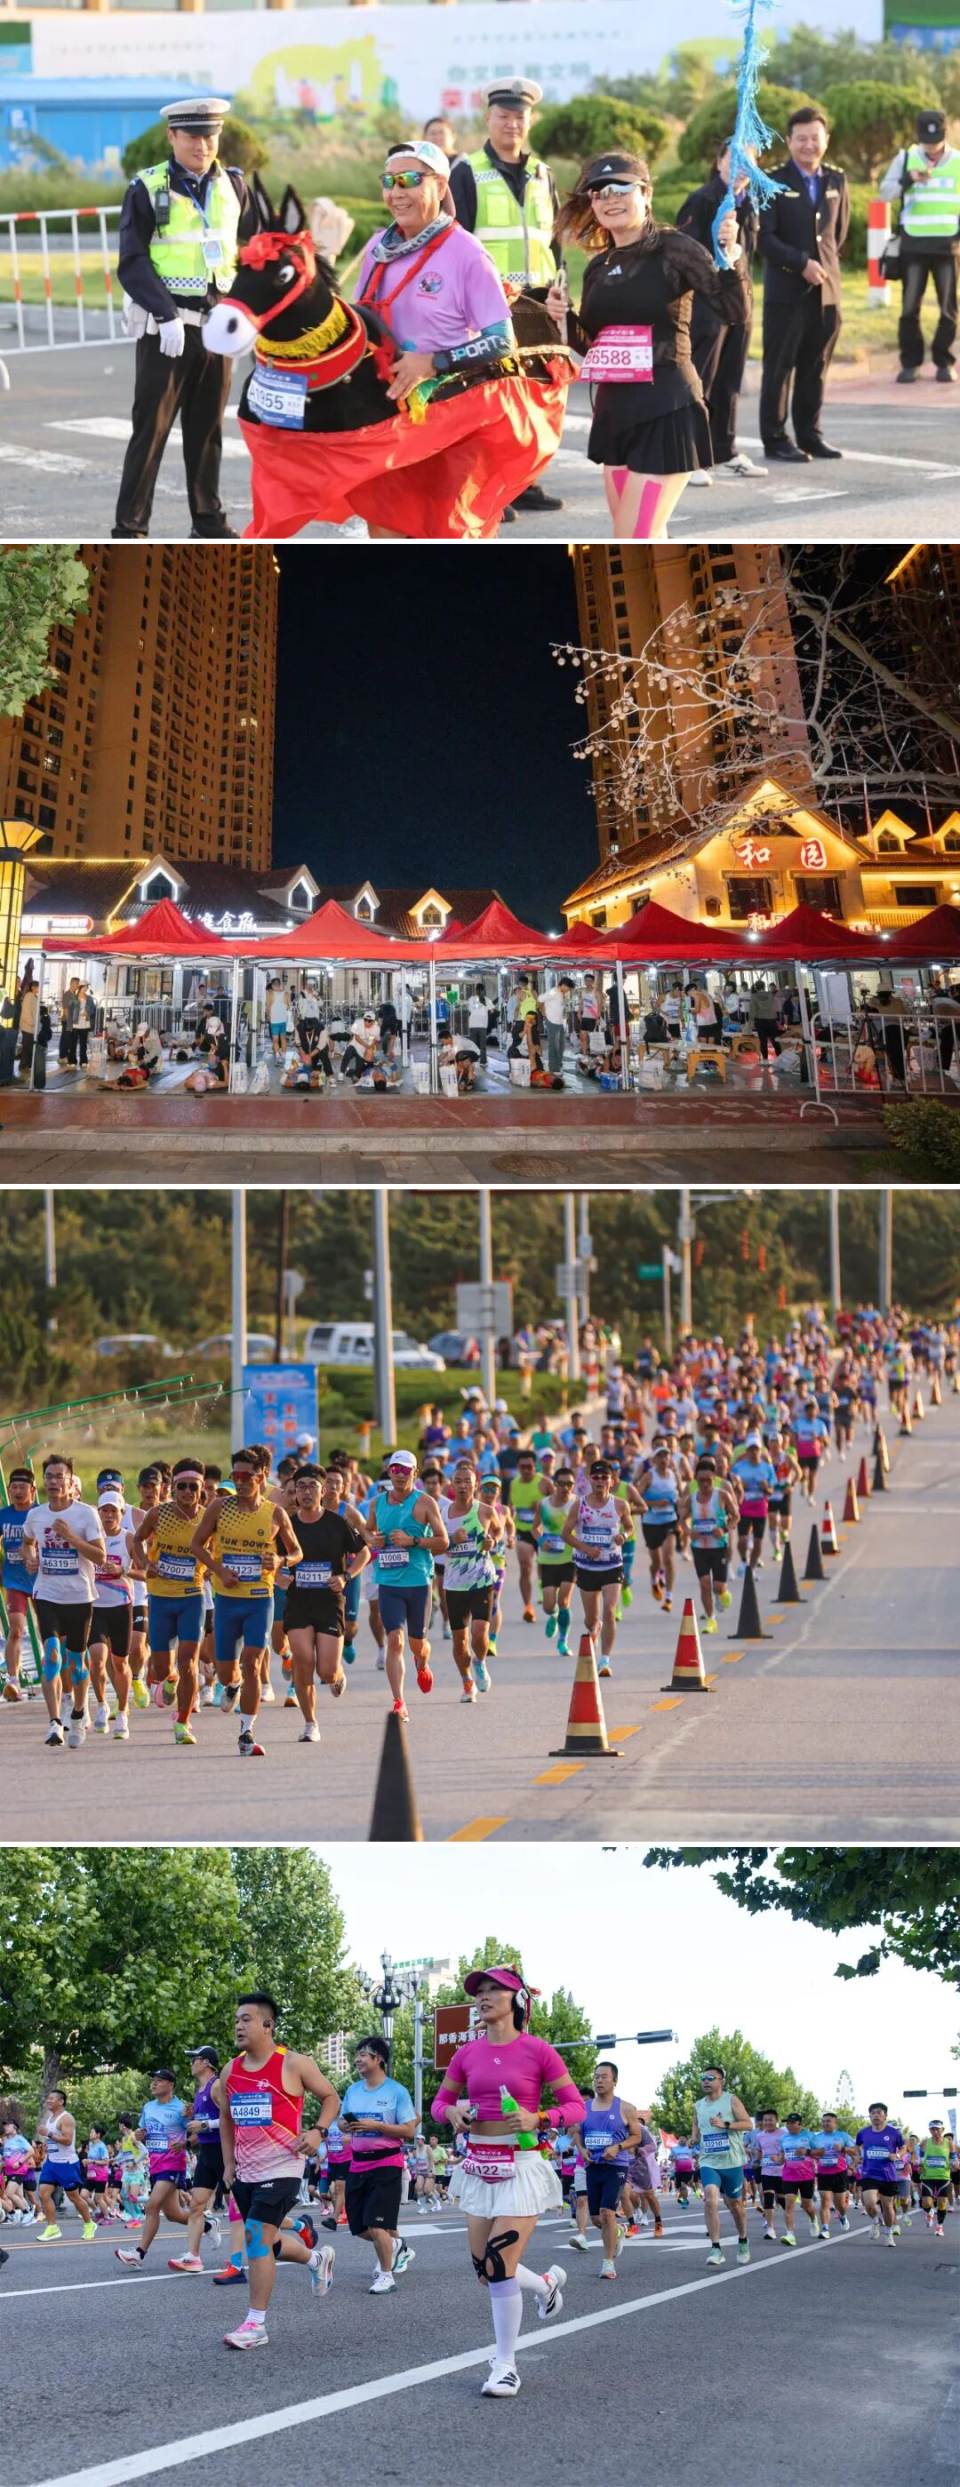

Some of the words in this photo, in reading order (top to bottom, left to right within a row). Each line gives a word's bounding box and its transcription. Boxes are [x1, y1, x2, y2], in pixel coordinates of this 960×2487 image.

[220, 1536, 238, 1546] RUN
[583, 1534, 605, 1543] A2110
[43, 1558, 69, 1568] A6319
[380, 1554, 402, 1562] A1008
[159, 1563, 187, 1575] A7007
[297, 1572, 322, 1581] A4211
[232, 2106, 260, 2117] A4849
